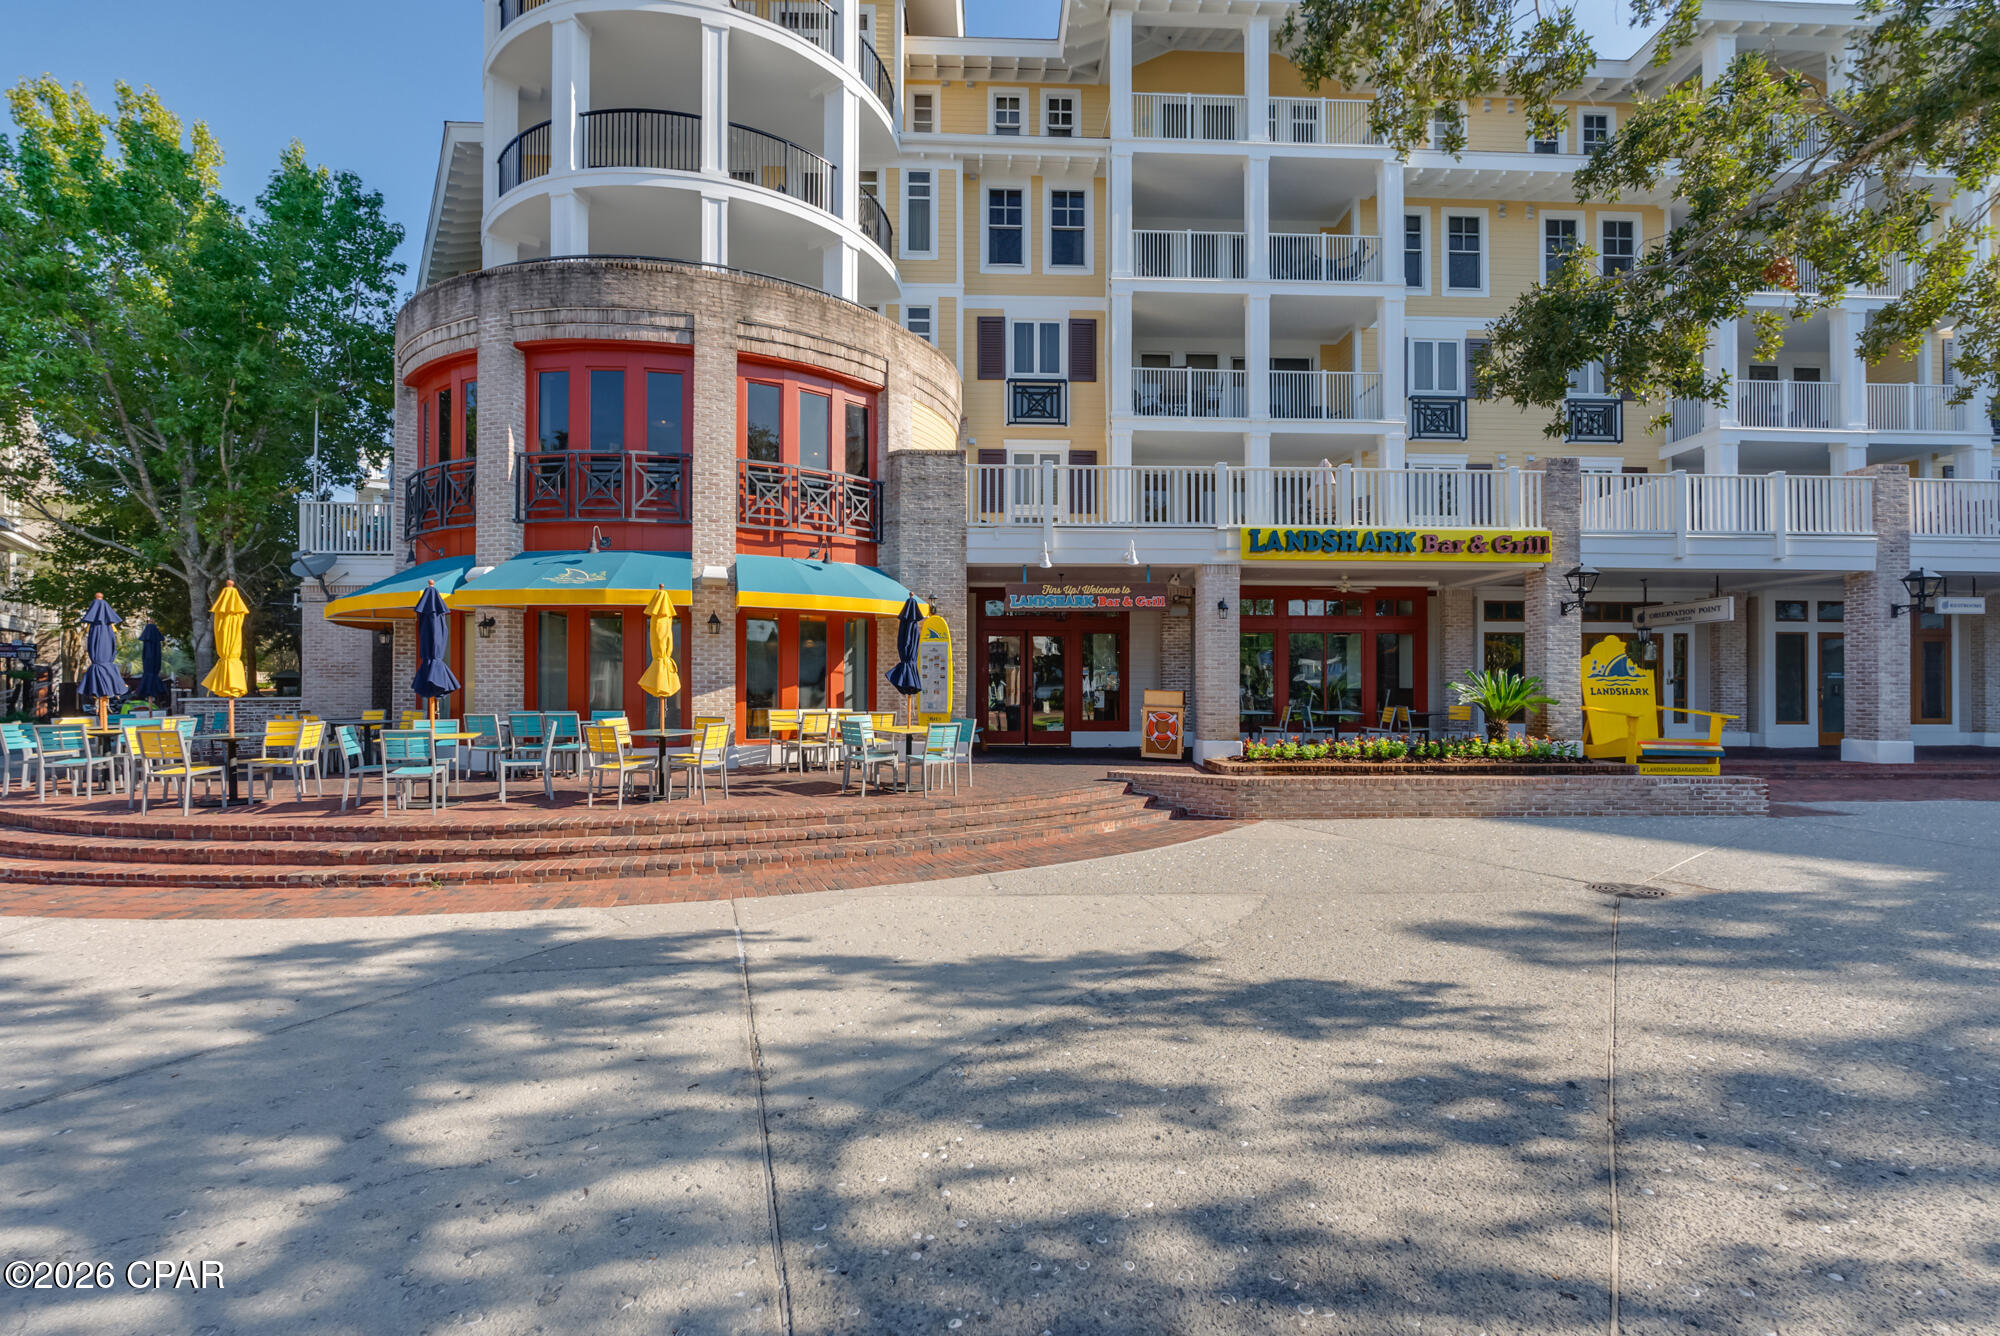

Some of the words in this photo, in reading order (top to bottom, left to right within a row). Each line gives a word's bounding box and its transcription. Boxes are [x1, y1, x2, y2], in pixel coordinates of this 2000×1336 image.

[1249, 529, 1417, 553] LANDSHARK
[1421, 534, 1466, 554] Bar
[1467, 534, 1490, 554] &
[1492, 534, 1551, 555] Grill
[1042, 584, 1061, 595] Fins
[1063, 584, 1081, 597] Up!
[1082, 584, 1121, 595] Welcome
[1122, 584, 1132, 595] to
[1010, 594, 1096, 609] LANDSHARK
[1098, 595, 1121, 608] Bar
[1122, 595, 1133, 608] &
[1135, 595, 1166, 608] Grill
[1649, 607, 1696, 619] OBSERVATION
[1698, 604, 1722, 615] POINT
[1590, 687, 1649, 696] LANDSHARK
